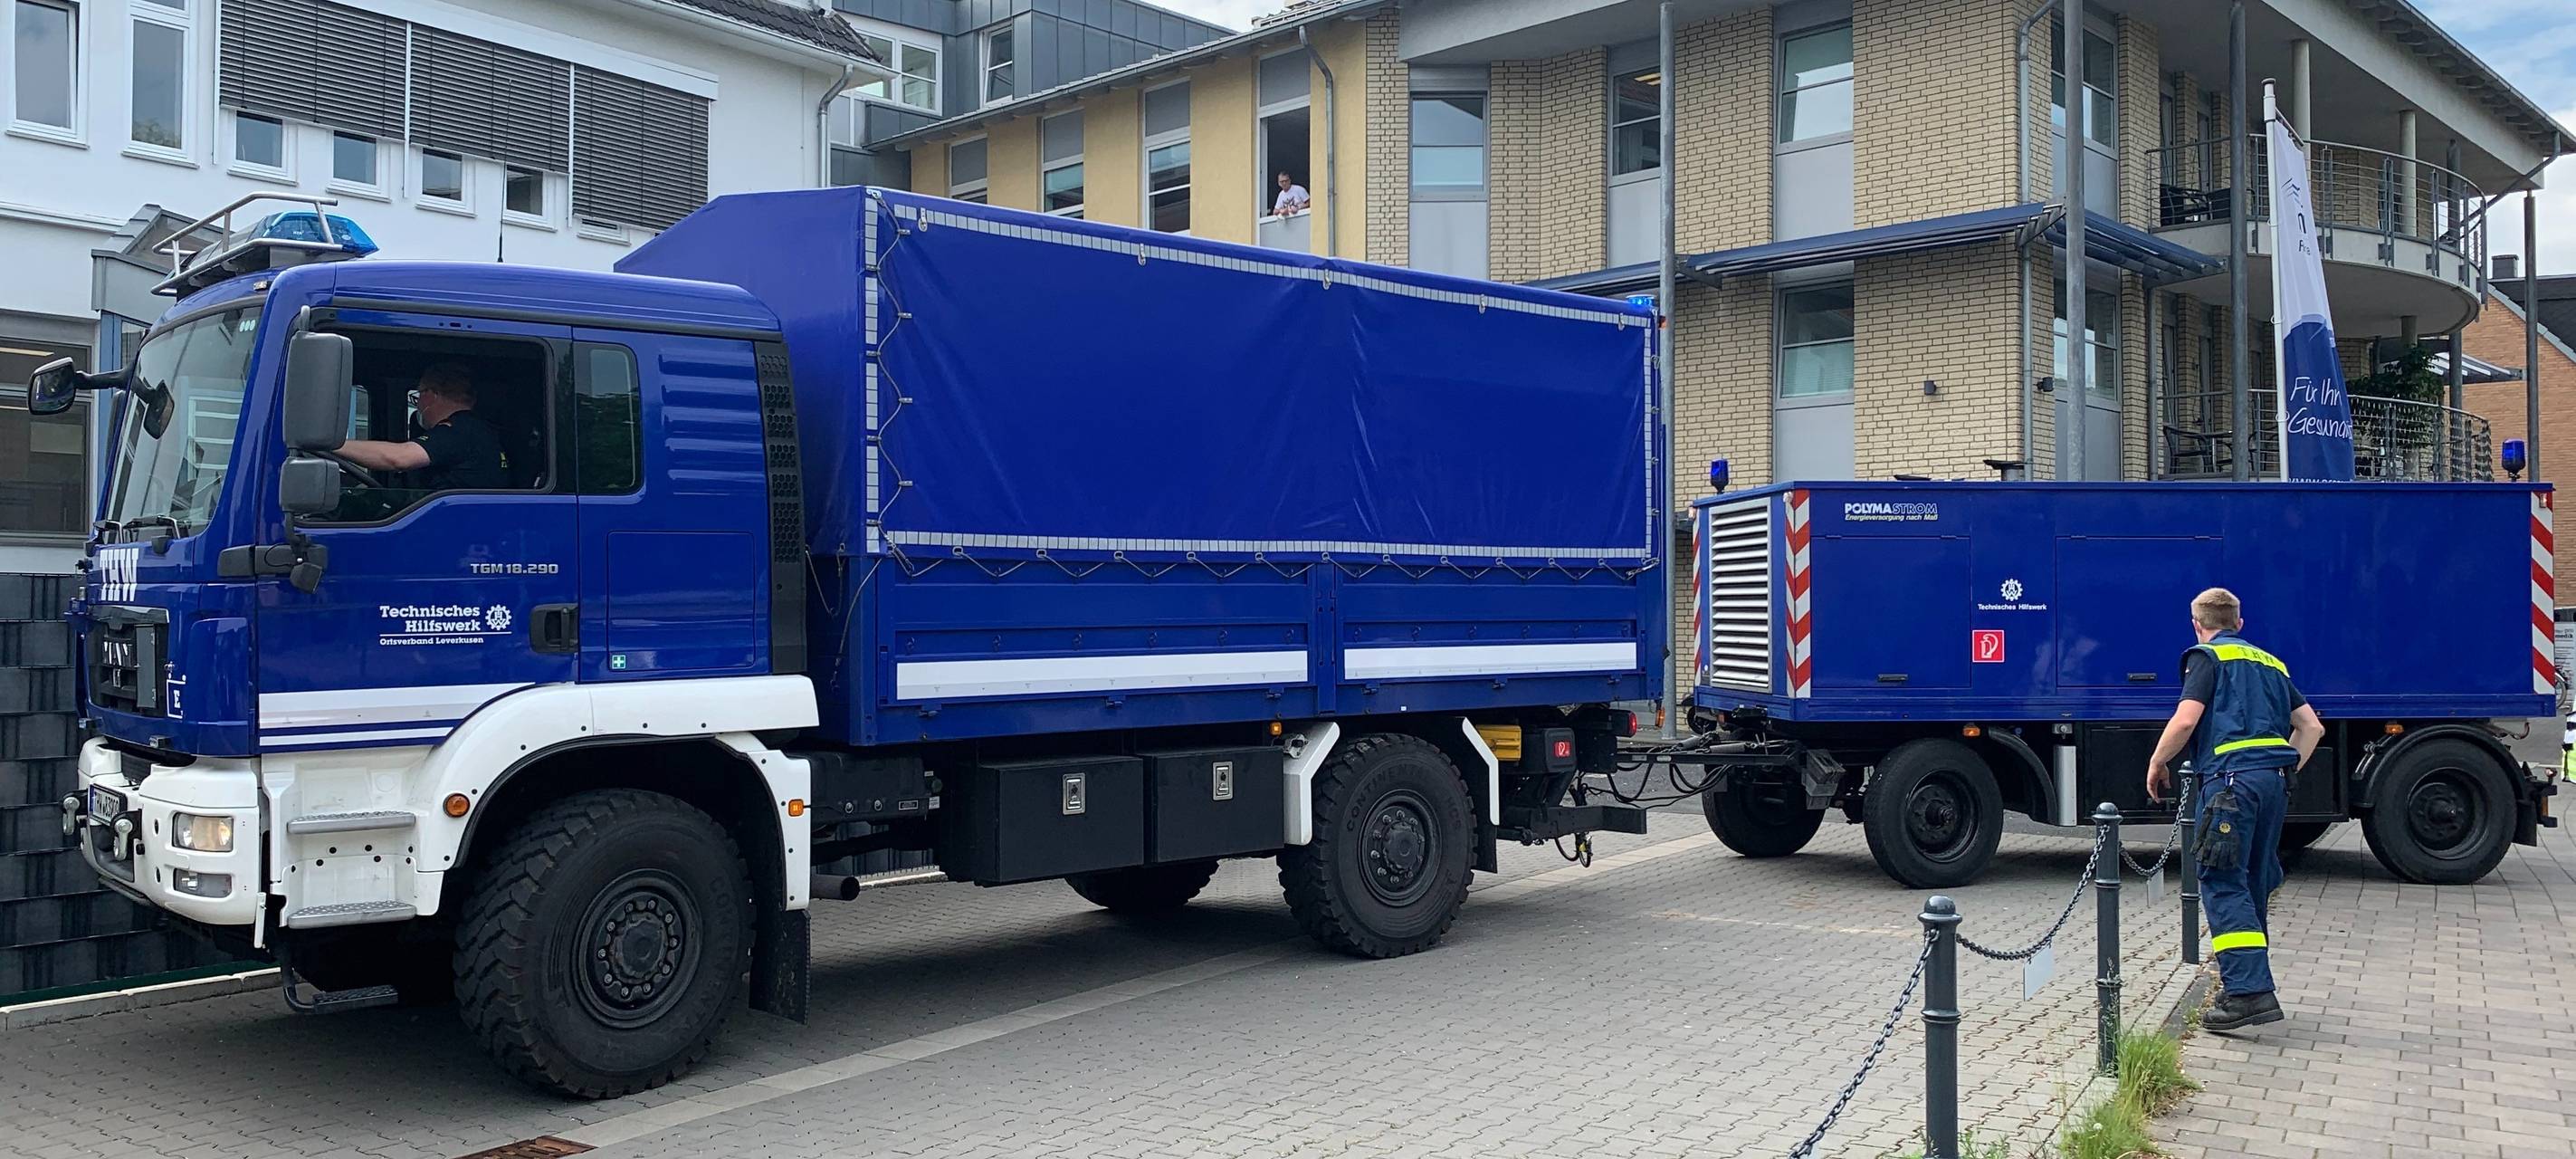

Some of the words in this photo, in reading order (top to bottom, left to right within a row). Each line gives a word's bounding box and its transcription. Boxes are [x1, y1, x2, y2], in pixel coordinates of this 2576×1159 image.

[1844, 503, 1938, 514] POLYMASTROM
[470, 563, 503, 574] TGM
[506, 563, 558, 574] 18.290
[100, 548, 139, 602] THW
[379, 605, 481, 618] Technisches
[405, 619, 481, 633] Hilfswerk
[379, 637, 434, 646] Ortsverband
[435, 637, 484, 645] Leverkusen
